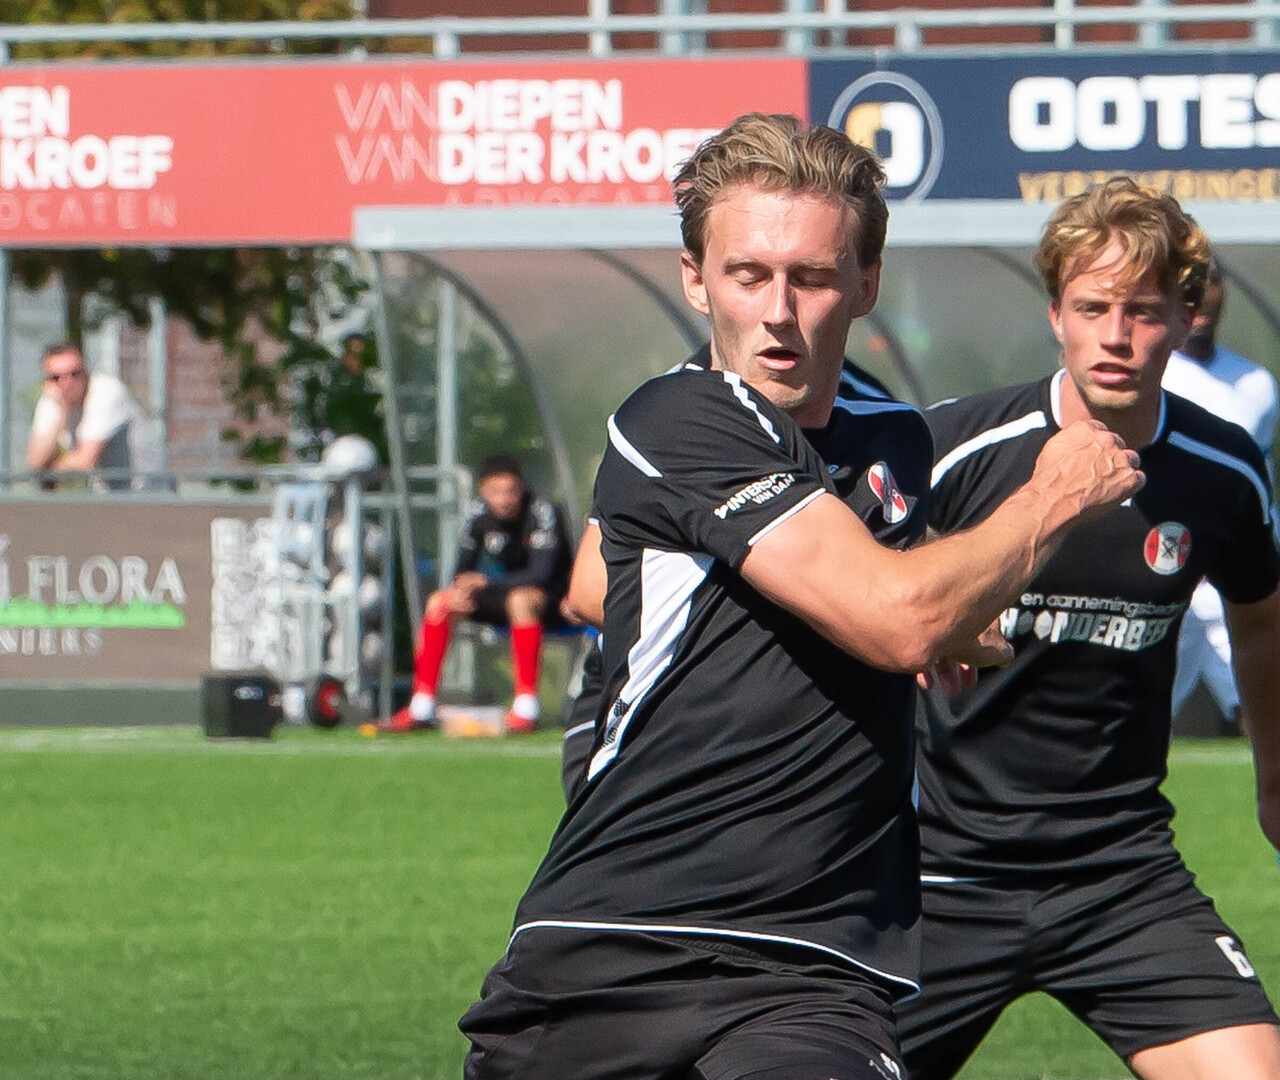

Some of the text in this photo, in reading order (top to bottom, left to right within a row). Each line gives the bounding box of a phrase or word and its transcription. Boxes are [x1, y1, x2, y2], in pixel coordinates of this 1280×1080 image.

[333, 78, 624, 132] VAN DIEPEN
[0, 135, 174, 190] KROEF
[333, 131, 438, 185] VAN
[438, 132, 546, 184] DER
[26, 554, 187, 606] FLORA
